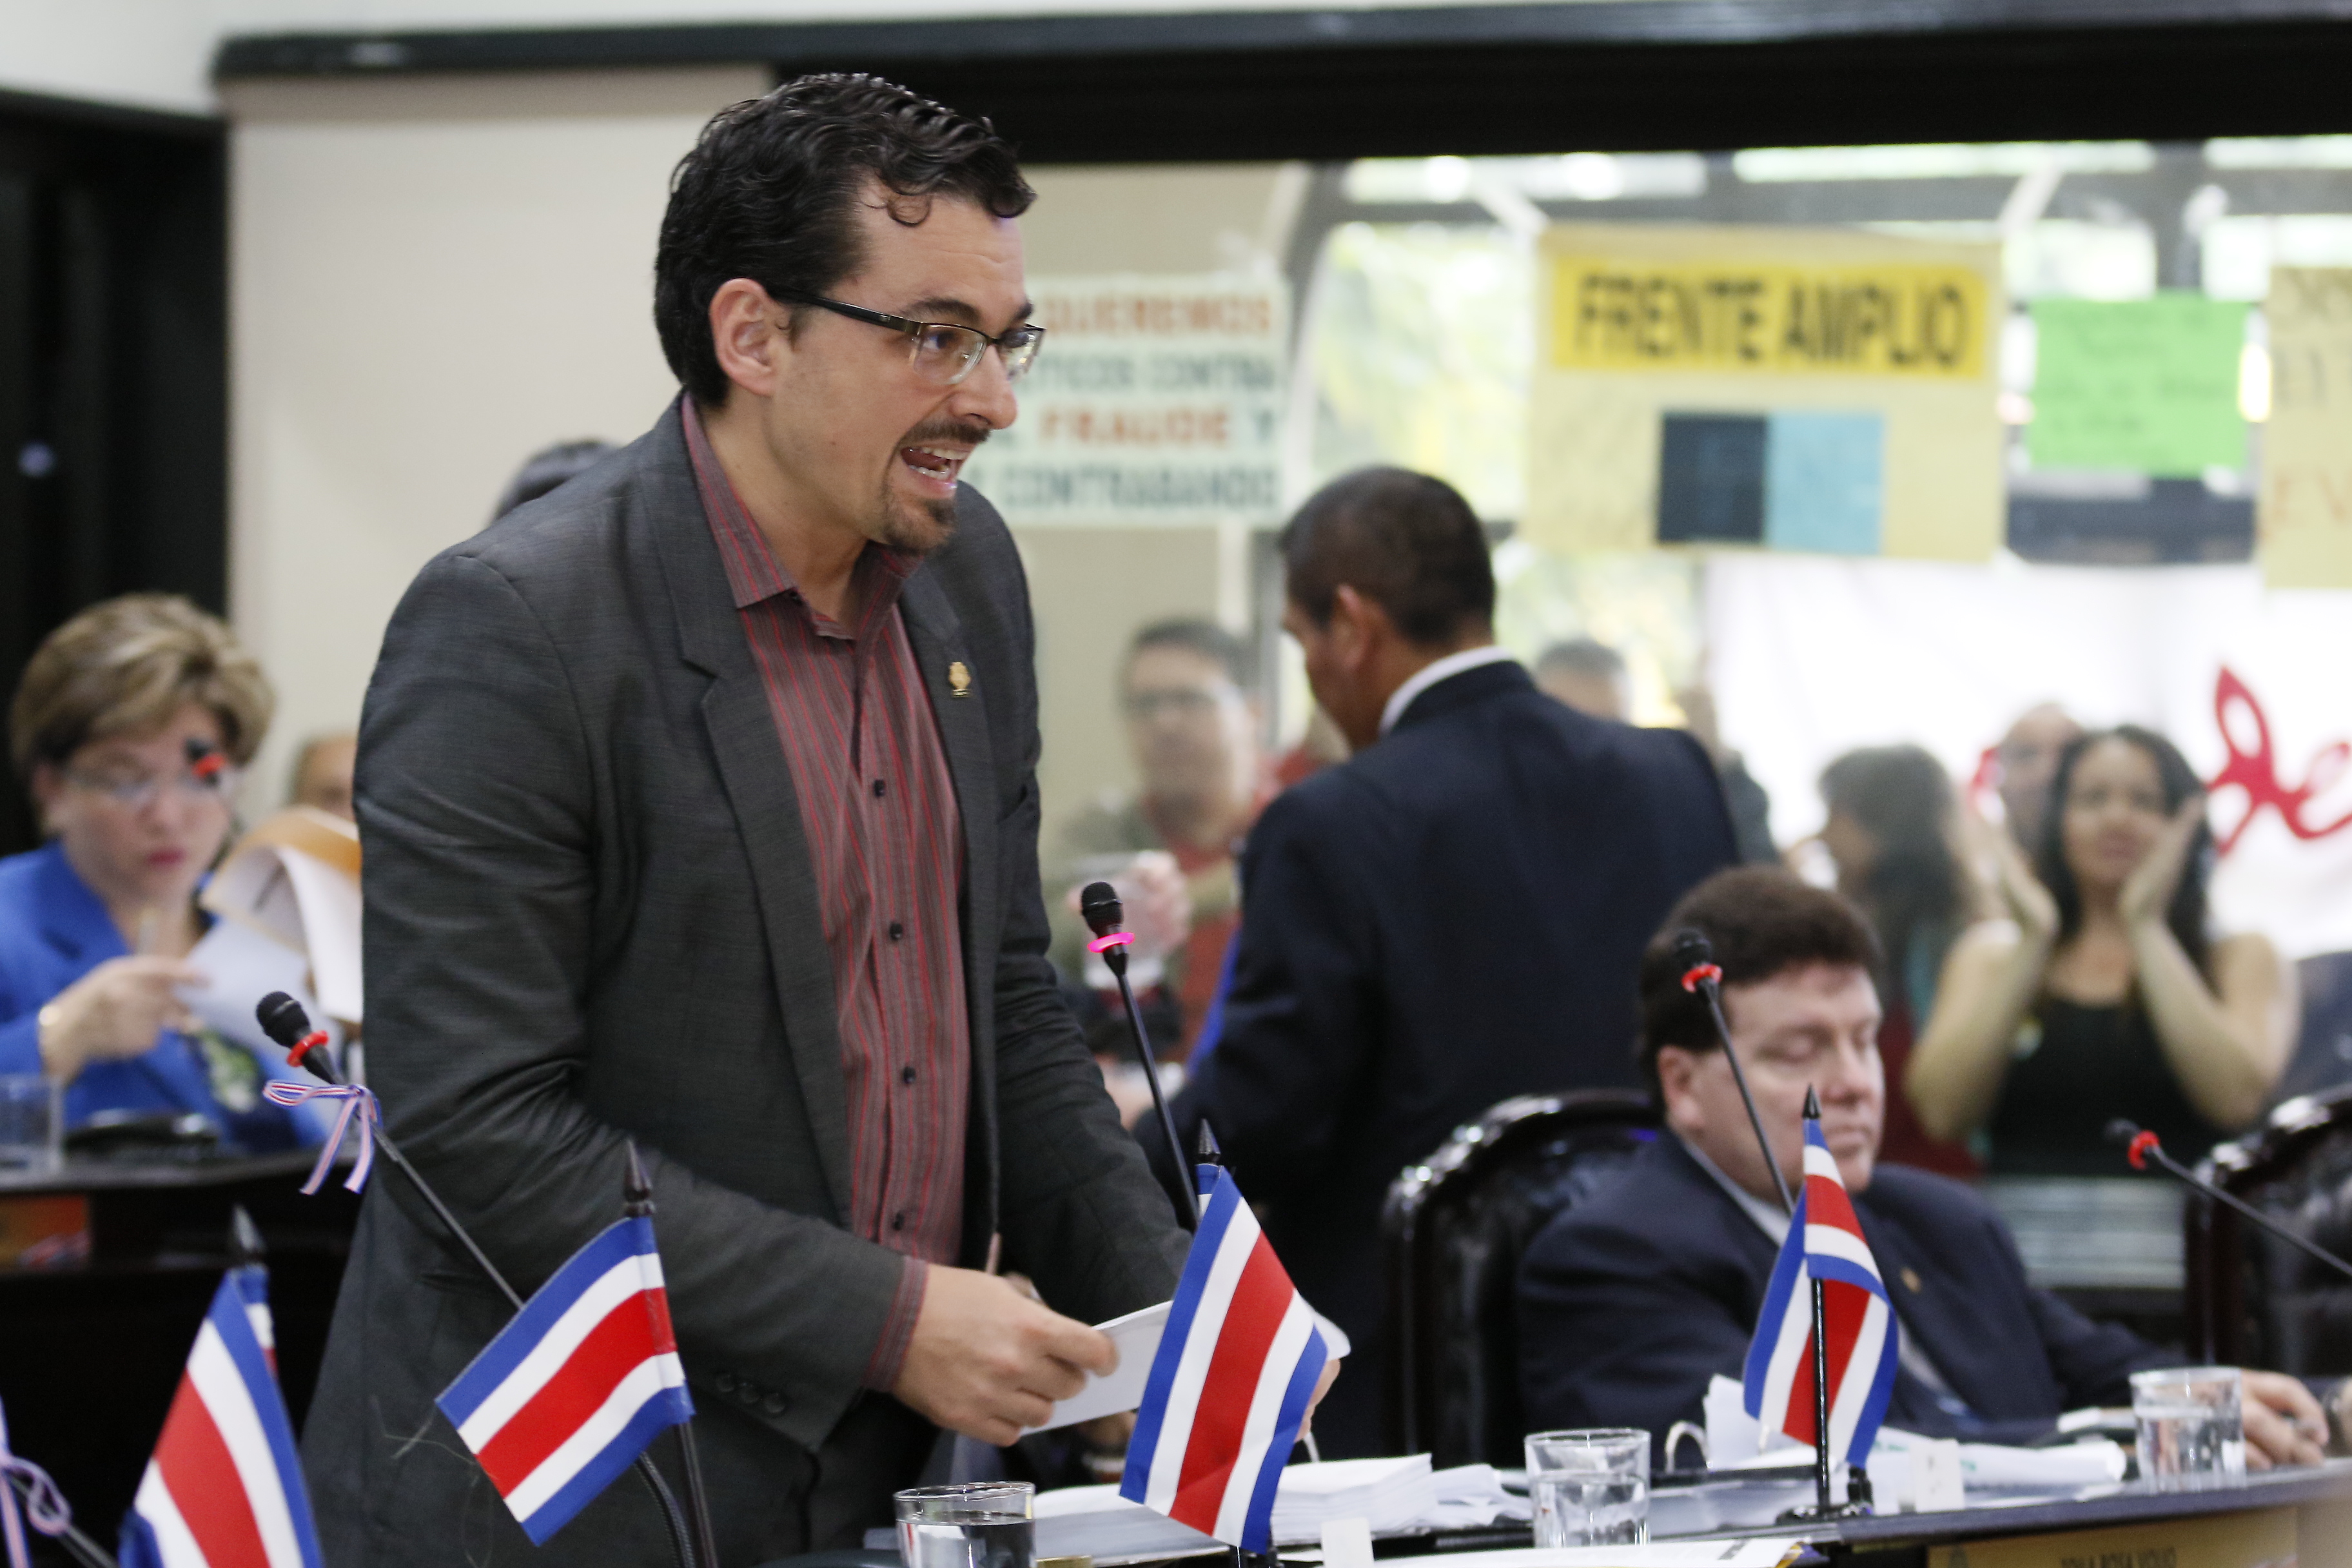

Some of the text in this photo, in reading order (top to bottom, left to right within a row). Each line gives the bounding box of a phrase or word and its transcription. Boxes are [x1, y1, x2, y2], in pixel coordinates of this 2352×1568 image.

[1576, 273, 1970, 368] FRENTE AMPLIO
[1039, 407, 1229, 447] FRAUDE
